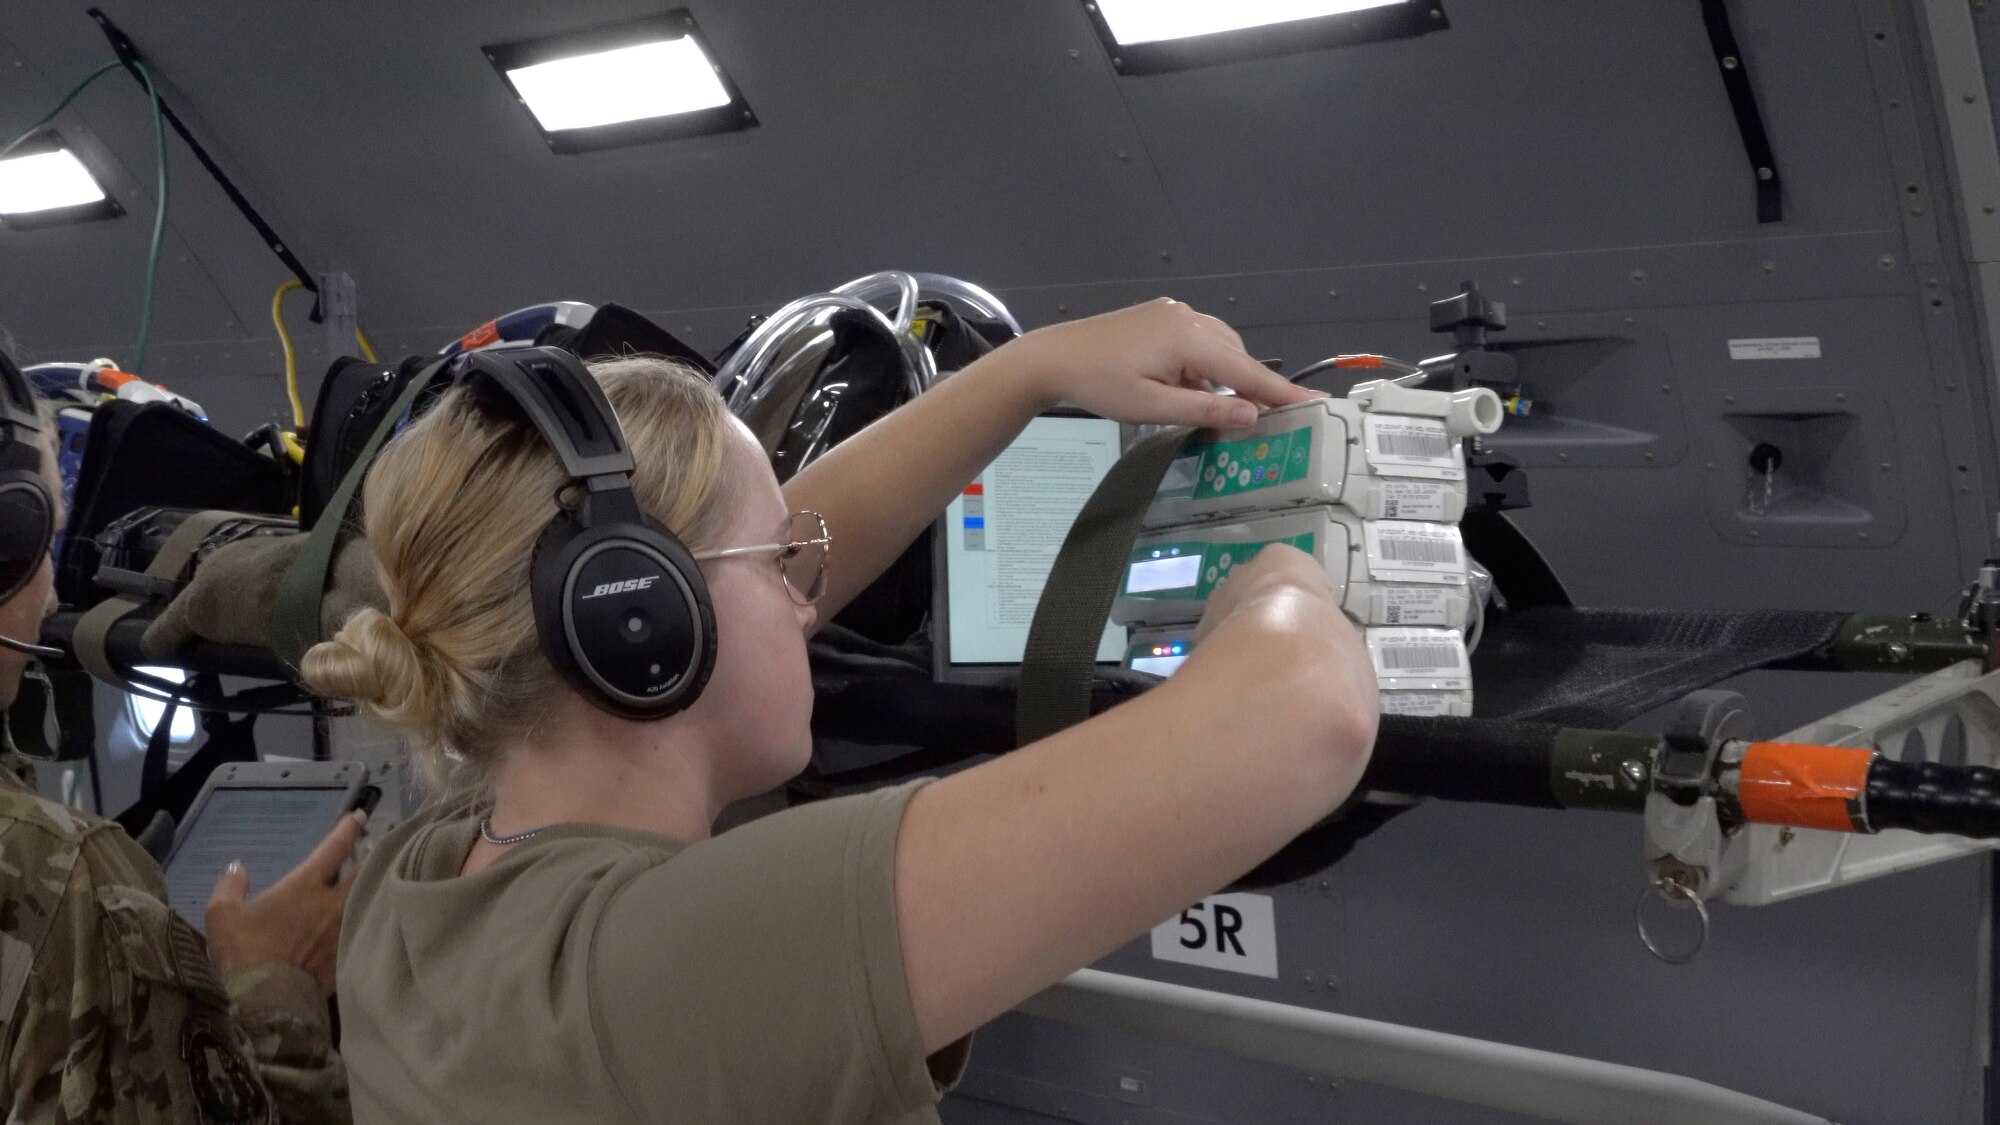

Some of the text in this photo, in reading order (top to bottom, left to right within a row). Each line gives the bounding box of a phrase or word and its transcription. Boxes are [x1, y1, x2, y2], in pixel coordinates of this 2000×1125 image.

[582, 576, 659, 599] BOSE
[659, 673, 680, 690] Aviation
[1179, 902, 1247, 957] 5R
